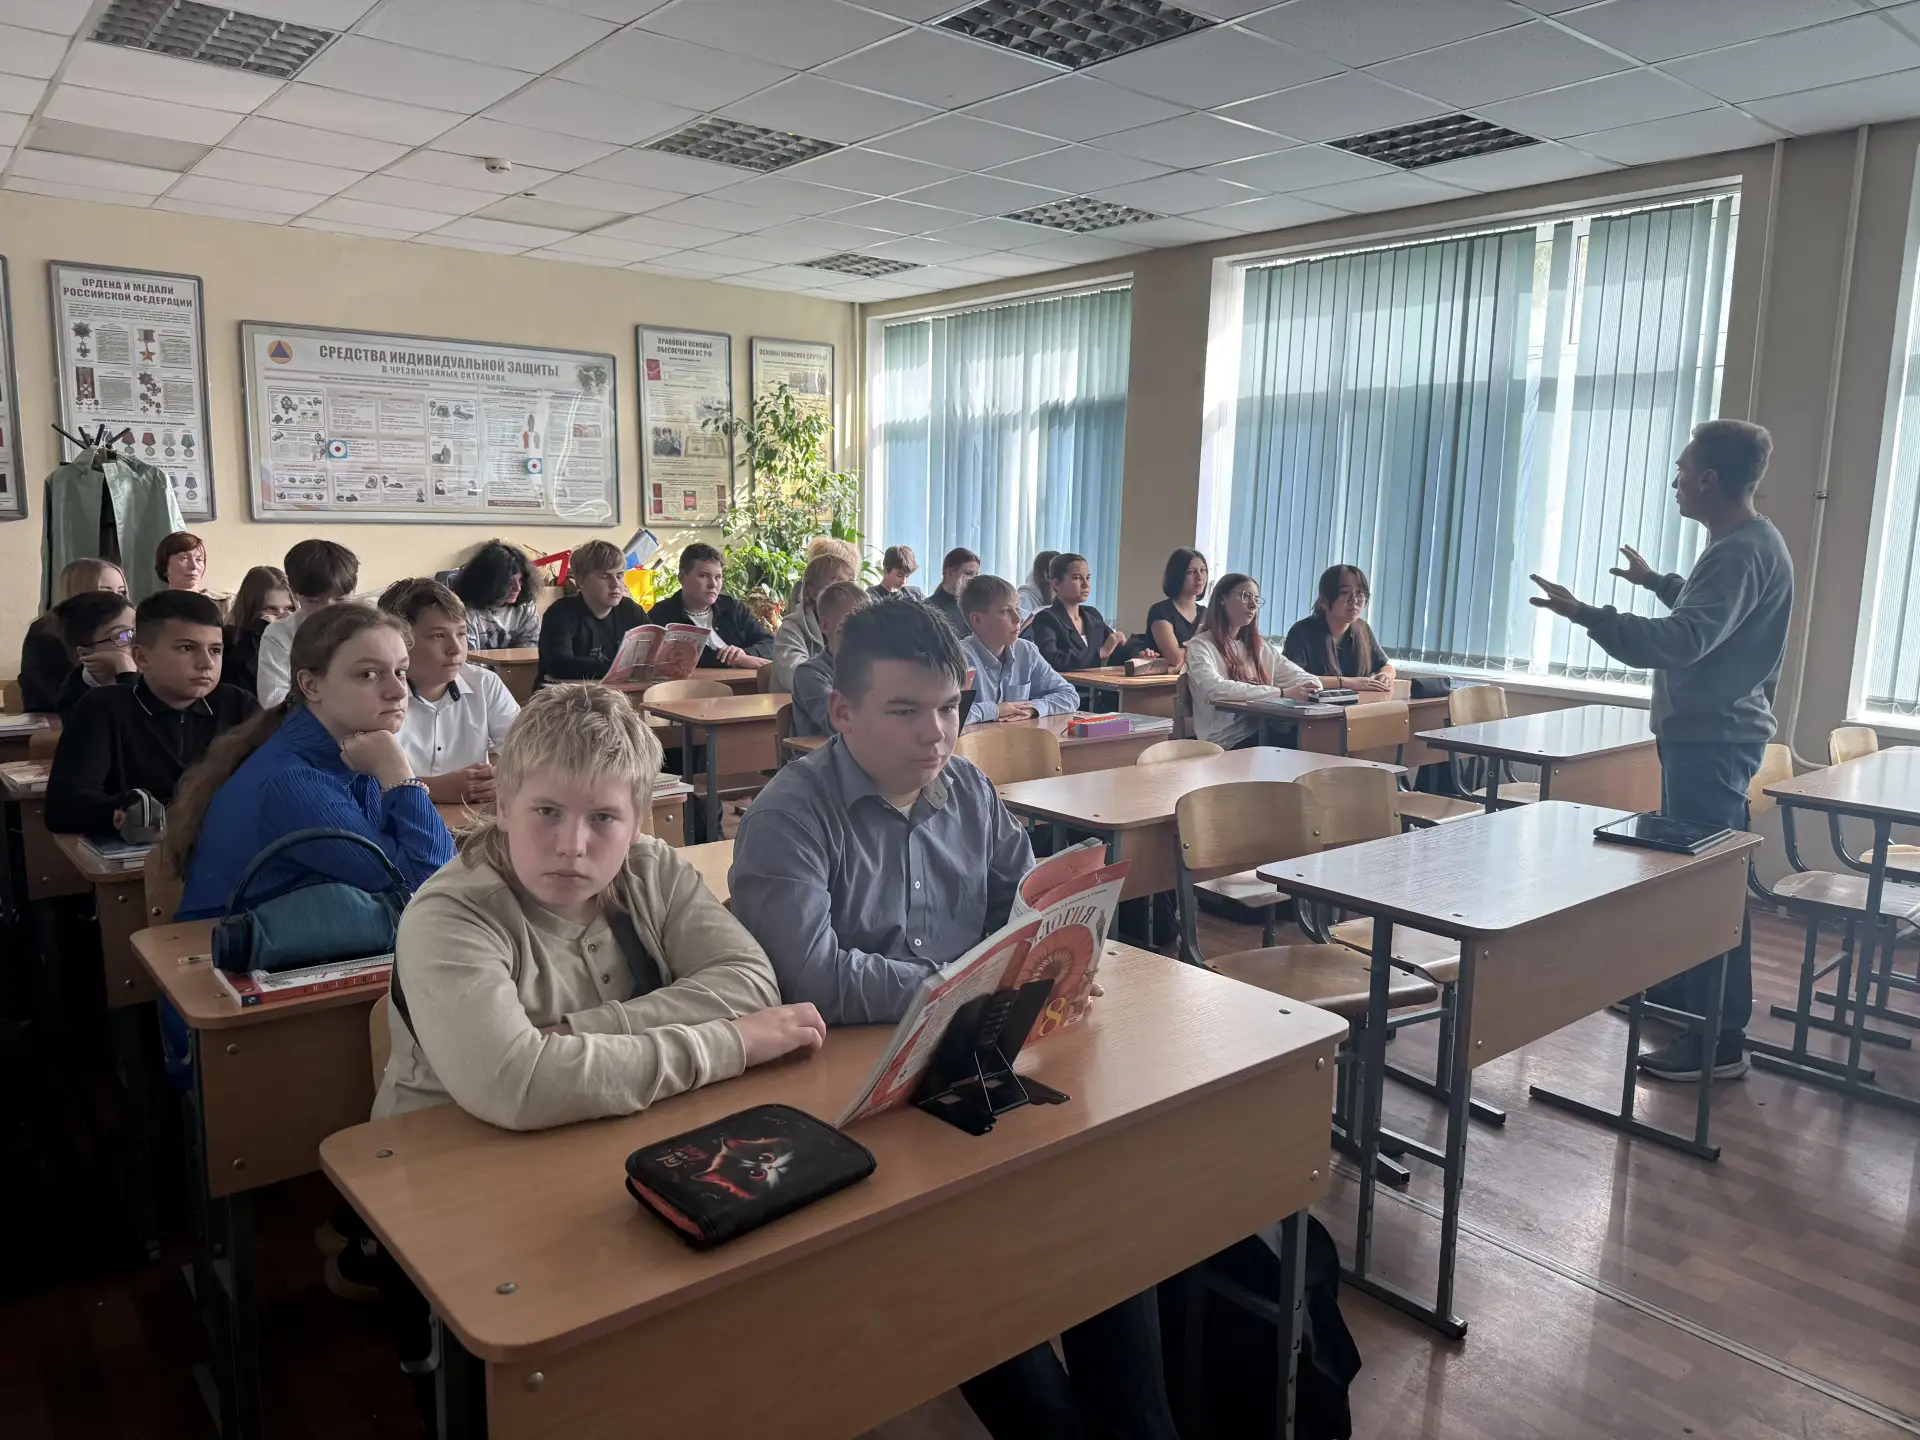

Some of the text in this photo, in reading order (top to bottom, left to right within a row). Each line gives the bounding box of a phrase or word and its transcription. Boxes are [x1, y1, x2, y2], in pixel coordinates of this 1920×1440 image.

[63, 287, 193, 307] РОССИЙСКОЙ ФЕДЕРАЦИИ
[82, 278, 174, 295] ОРДЕНА И МЕДАЛИ
[319, 345, 559, 377] СРЕДСТВА ИНДИВИДУАЛЬНОЙ ЗАЩИТЫ
[381, 365, 507, 382] В ЧРЕЗВЫЧАЙНЫХ СИТУАЦИЯХ
[1036, 905, 1099, 943] ЛОГИЯ
[1038, 997, 1066, 1037] 8
